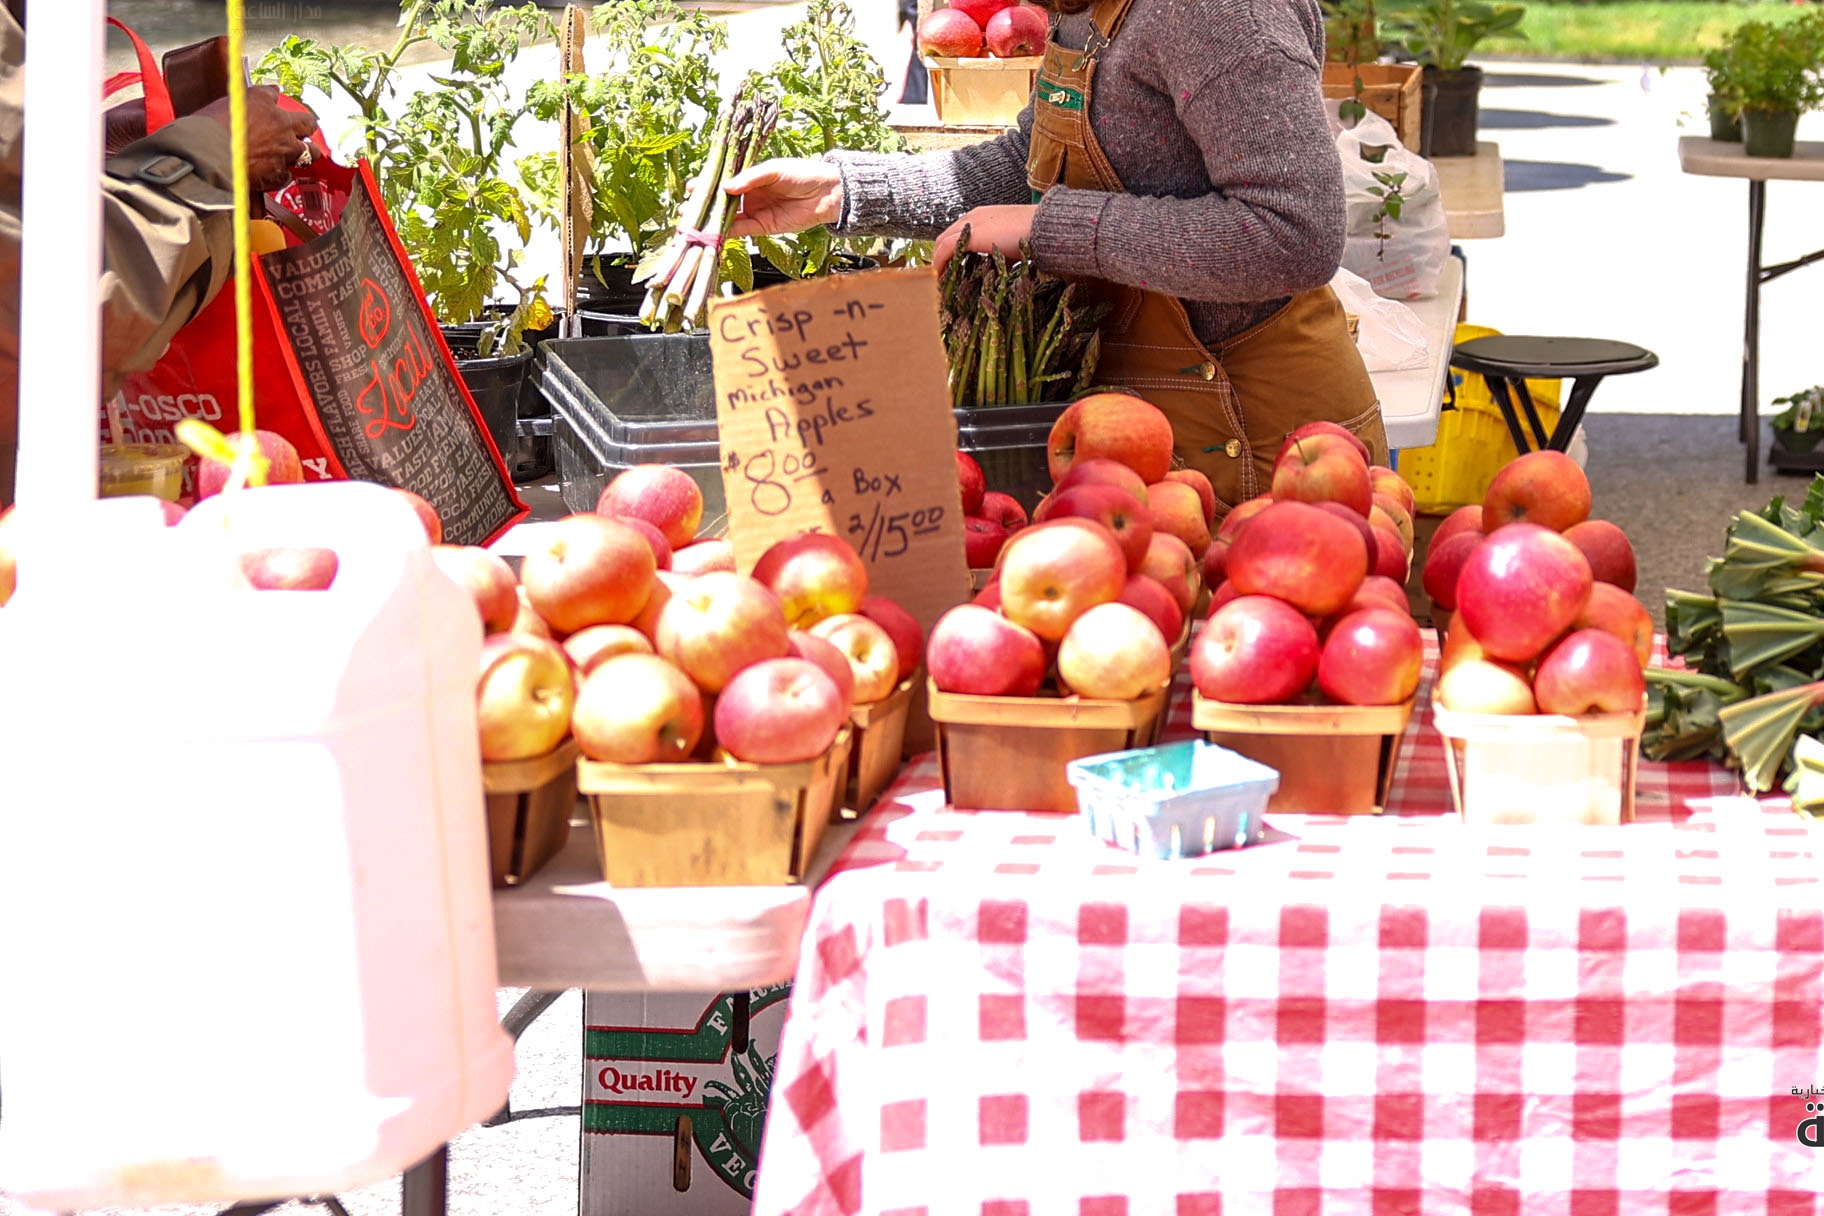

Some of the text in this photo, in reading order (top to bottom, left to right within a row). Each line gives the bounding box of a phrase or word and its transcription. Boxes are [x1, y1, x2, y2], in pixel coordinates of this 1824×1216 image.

[269, 243, 338, 280] VALUES
[277, 255, 355, 299] COMMUN
[327, 272, 361, 306] TAST
[306, 299, 339, 356] FAMILY
[720, 306, 813, 343] Crisp
[328, 344, 367, 373] SHOP
[741, 331, 869, 378] Sweet
[284, 299, 369, 476] RESH FLAVORS LOCAL
[727, 374, 844, 411] Michigan
[765, 396, 875, 448] Apples
[820, 466, 903, 506] a Box
[598, 1066, 698, 1099] Quality
